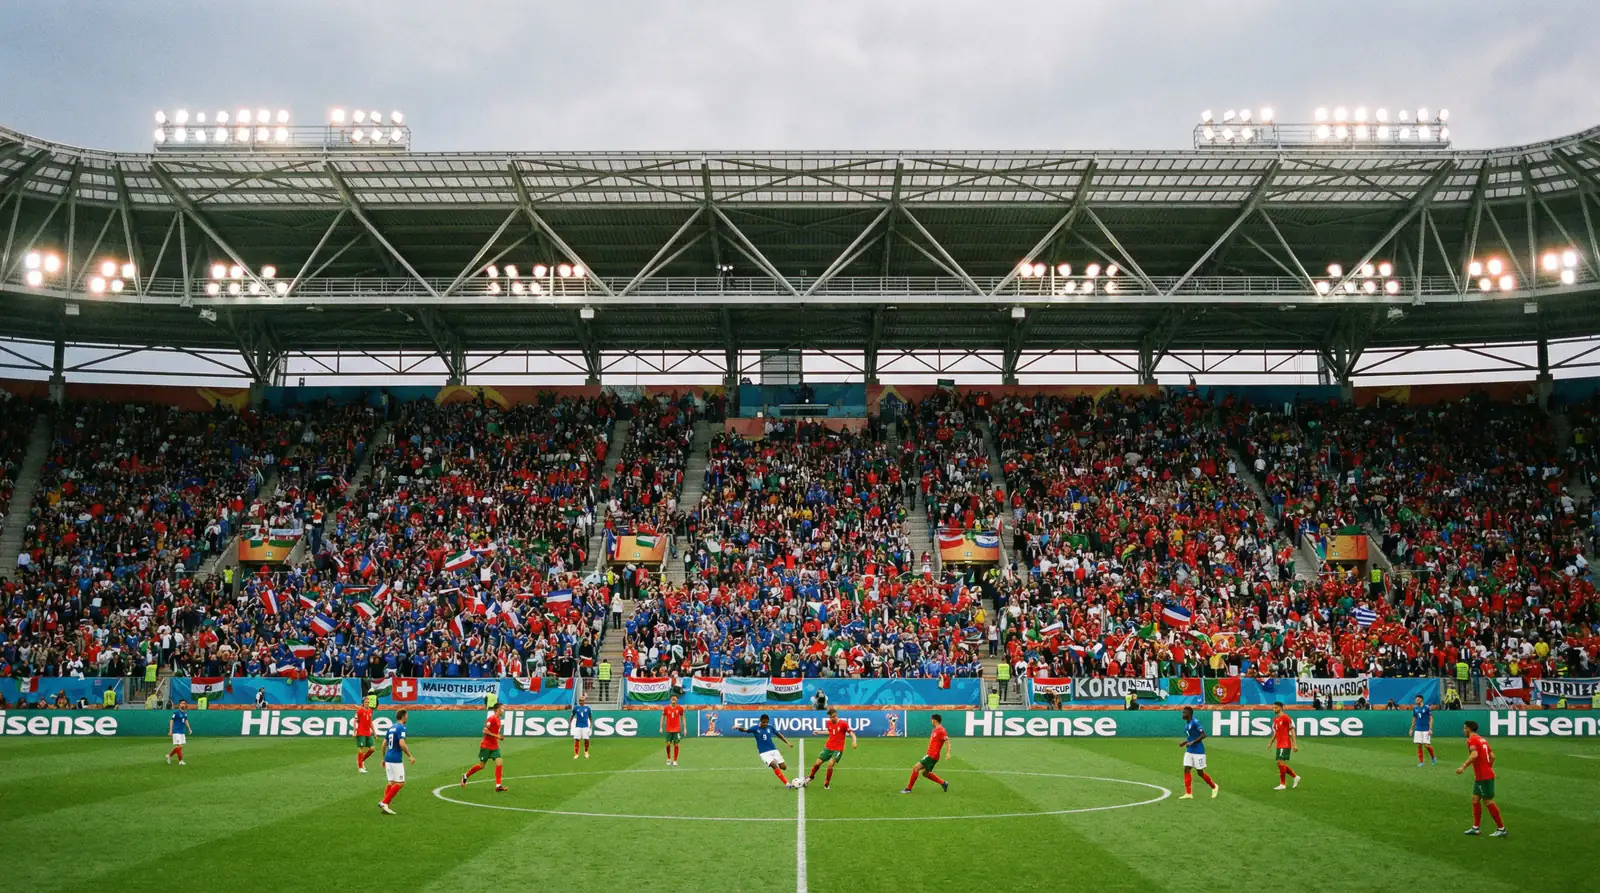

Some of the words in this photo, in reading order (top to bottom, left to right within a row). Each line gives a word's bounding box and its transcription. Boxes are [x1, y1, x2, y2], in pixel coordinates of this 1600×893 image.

[733, 717, 772, 732] FIF
[847, 717, 871, 731] UP
[965, 711, 1117, 736] Hisense
[1212, 711, 1364, 736] Hisnse
[1490, 711, 1600, 736] Hisen
